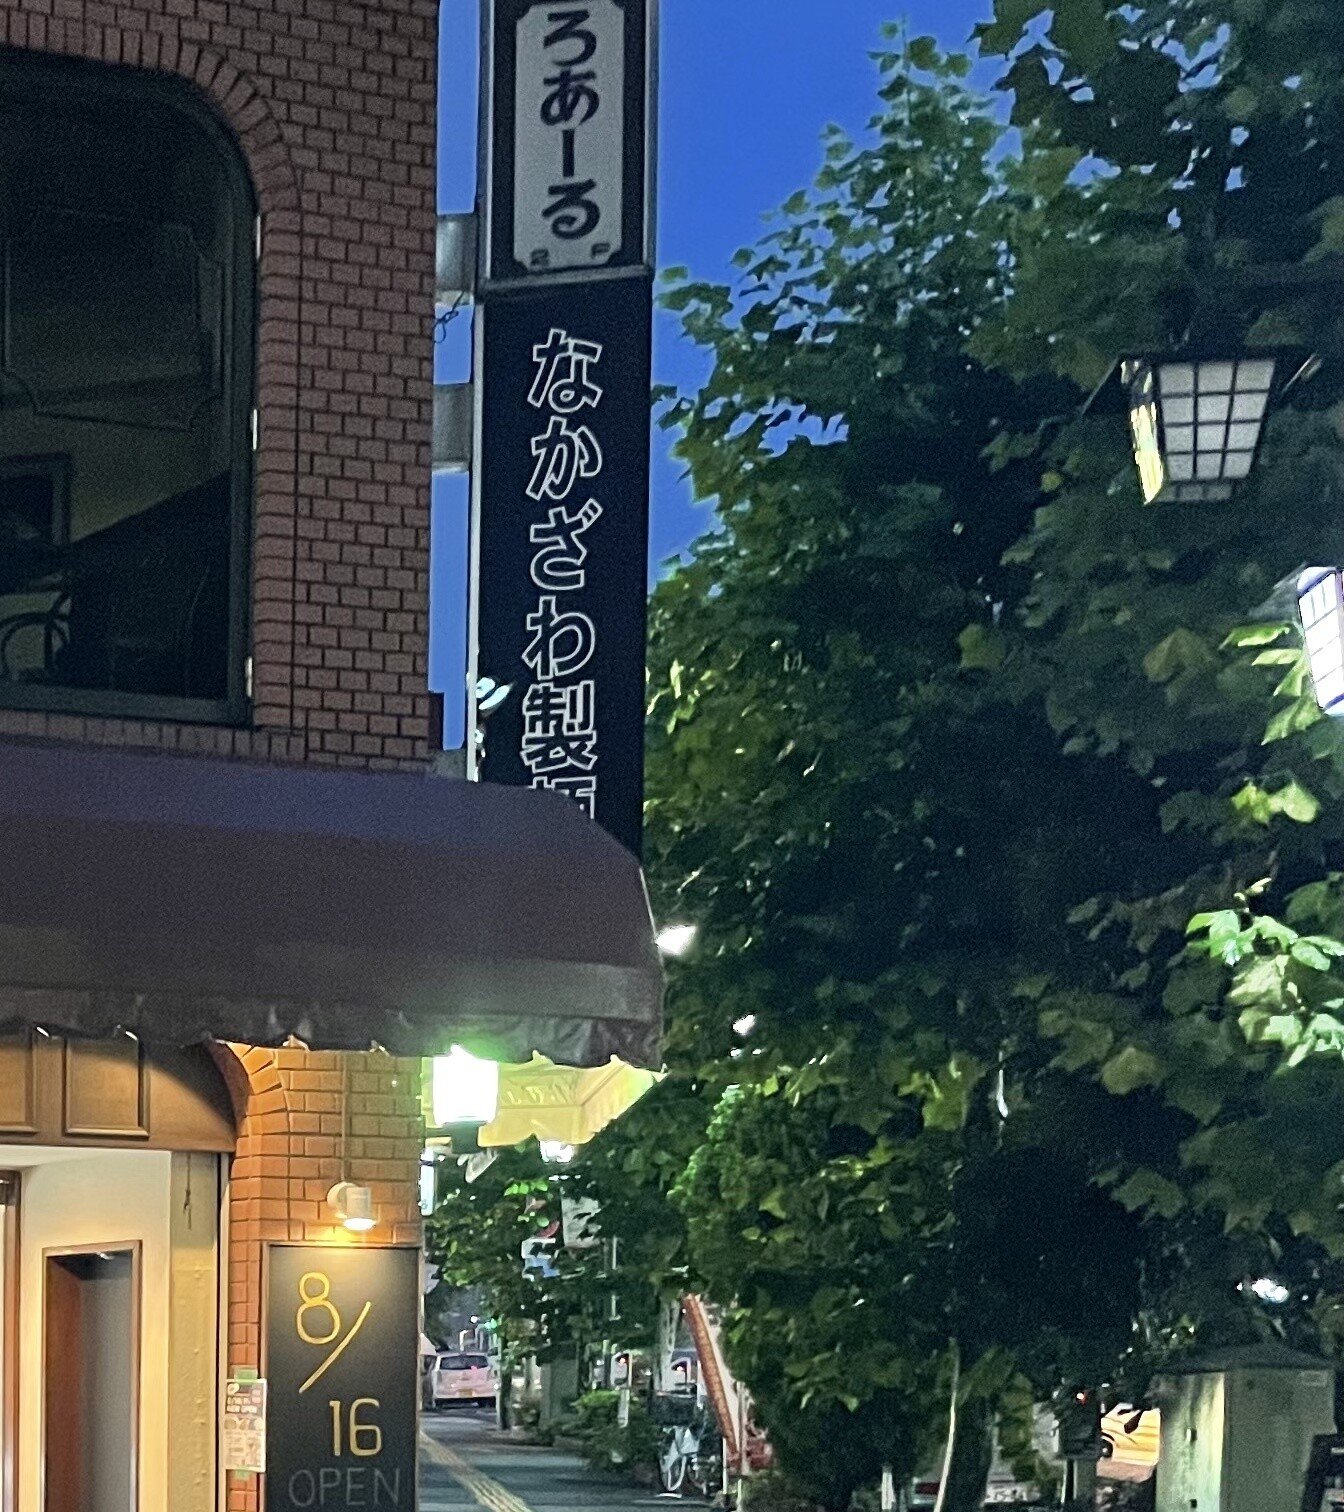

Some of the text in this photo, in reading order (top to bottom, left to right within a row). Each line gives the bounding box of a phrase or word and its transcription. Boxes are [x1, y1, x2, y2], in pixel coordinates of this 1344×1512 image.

[538, 9, 602, 241] ろあーる
[288, 1466, 402, 1507] OPEN
